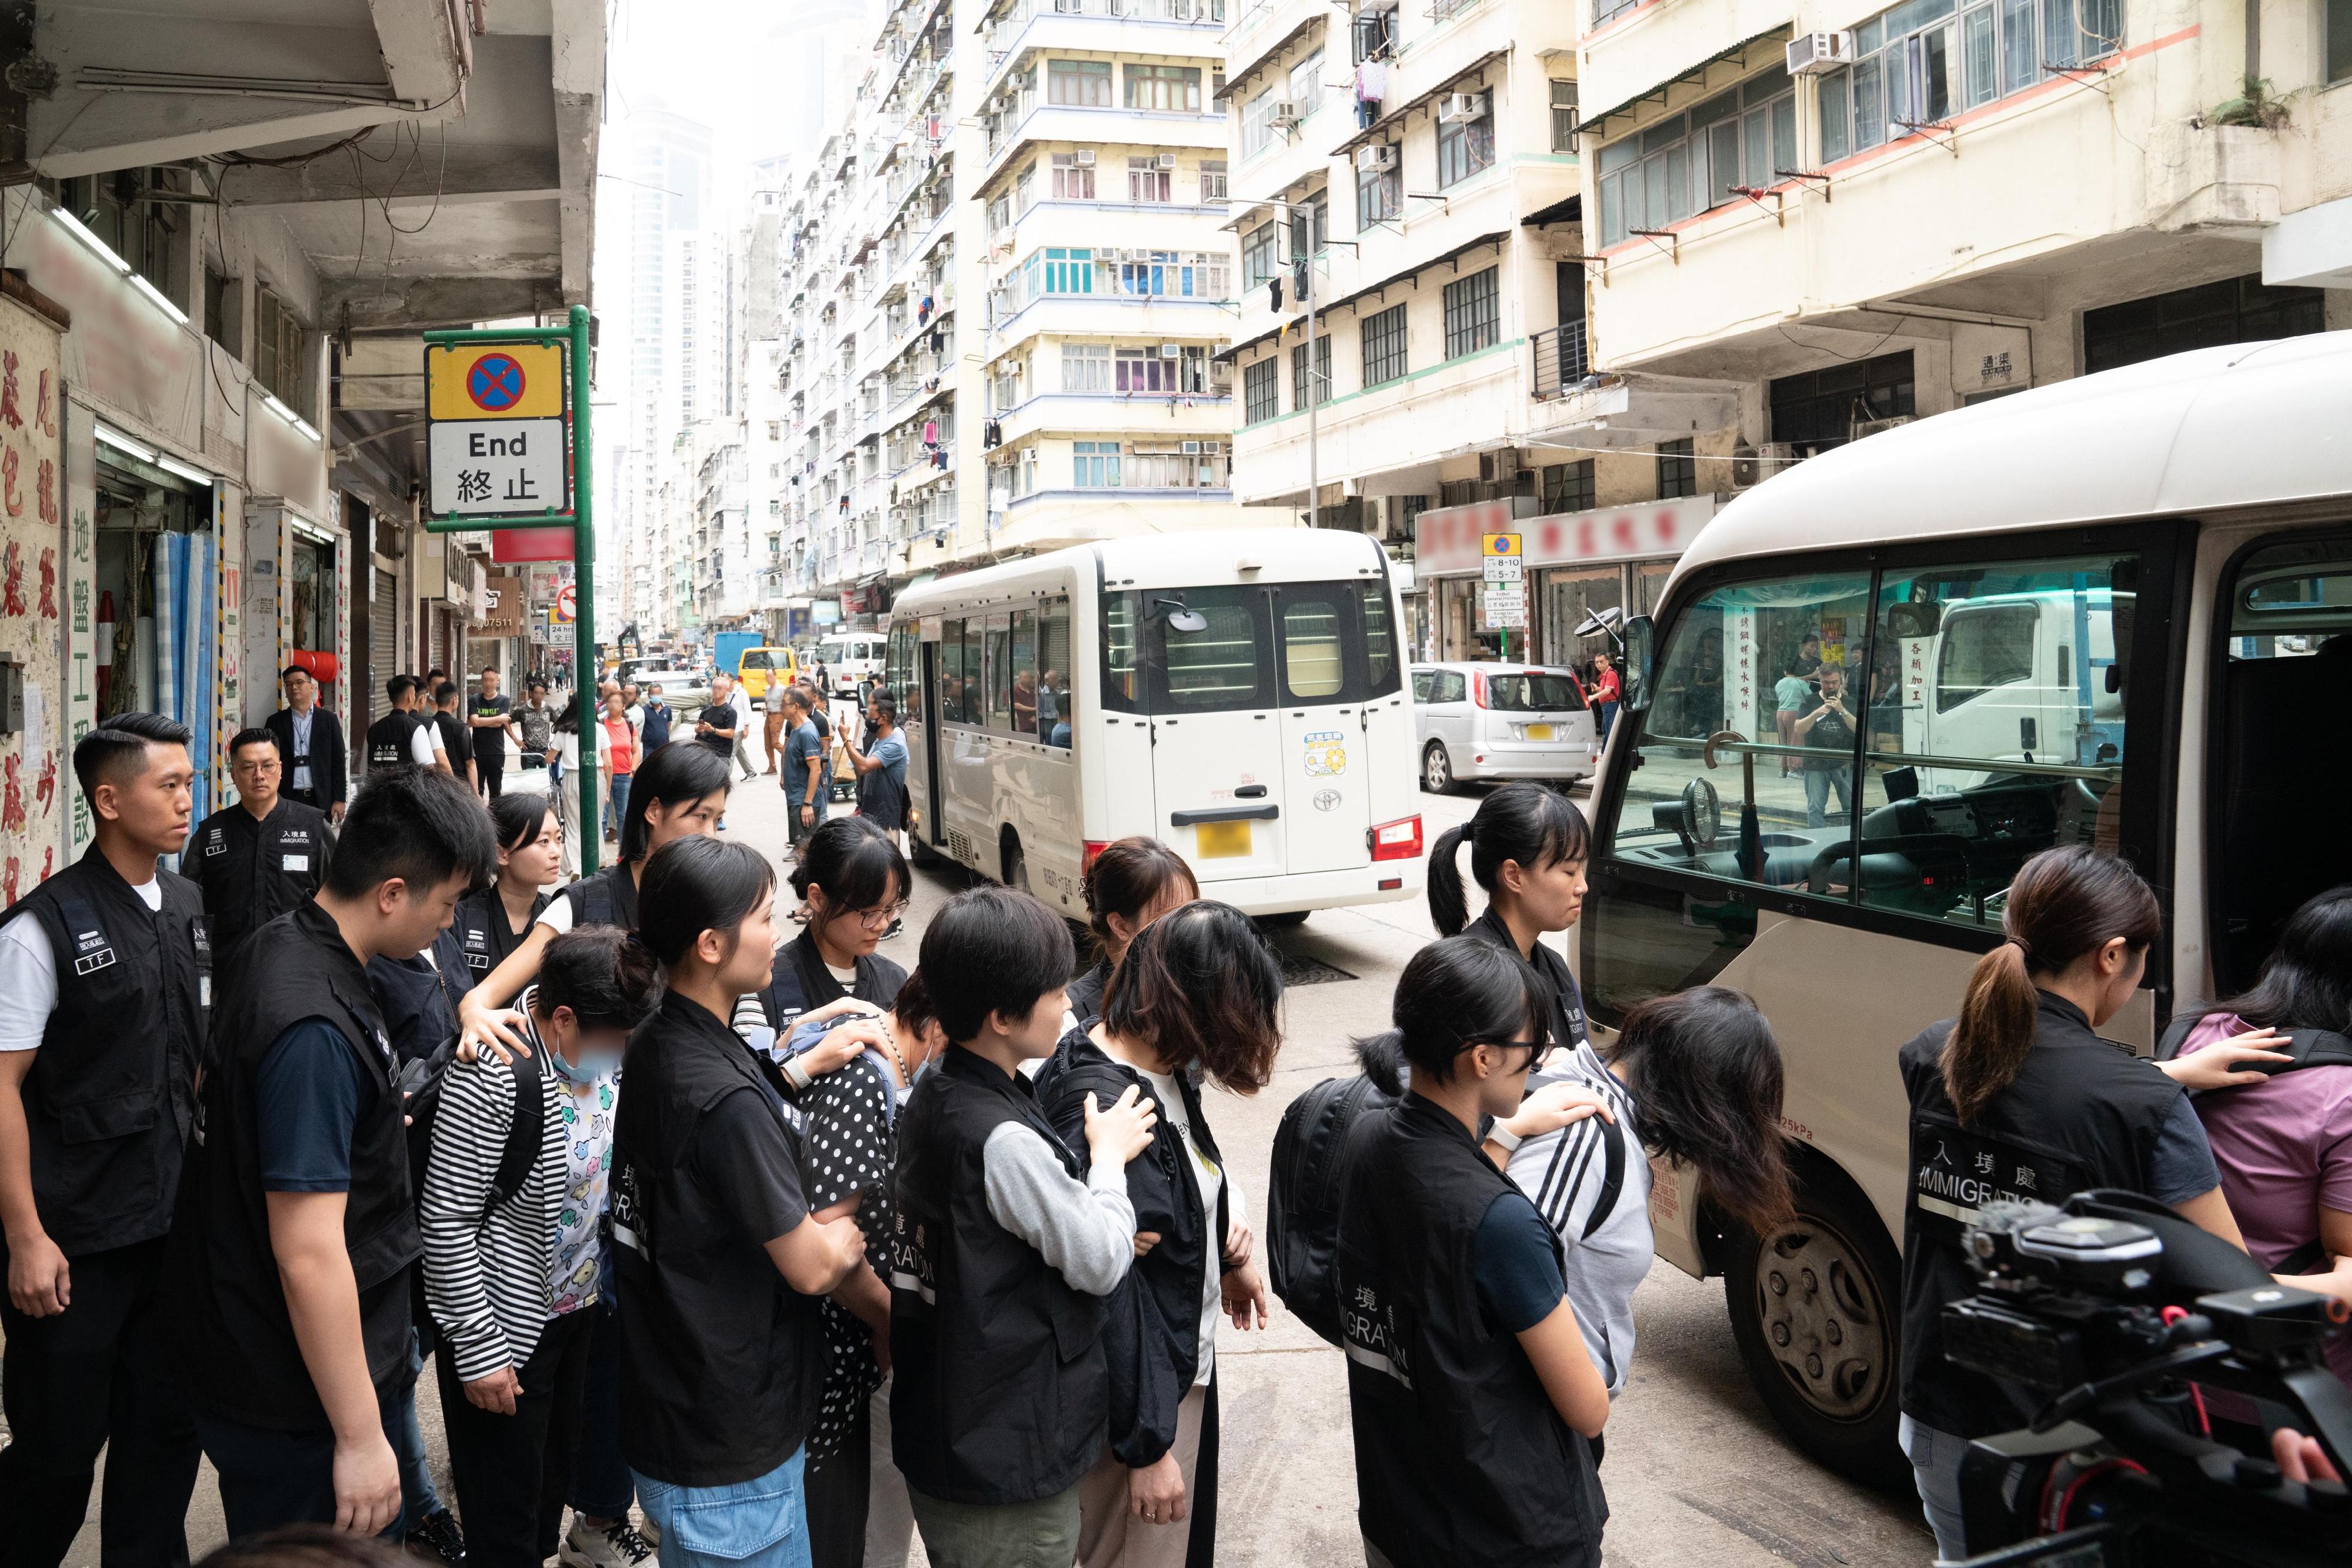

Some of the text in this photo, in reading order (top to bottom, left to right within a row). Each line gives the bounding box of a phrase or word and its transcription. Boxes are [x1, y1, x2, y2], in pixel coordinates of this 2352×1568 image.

[470, 432, 526, 457] End
[457, 468, 539, 503] 終止
[1933, 1140, 2037, 1191] 入境處
